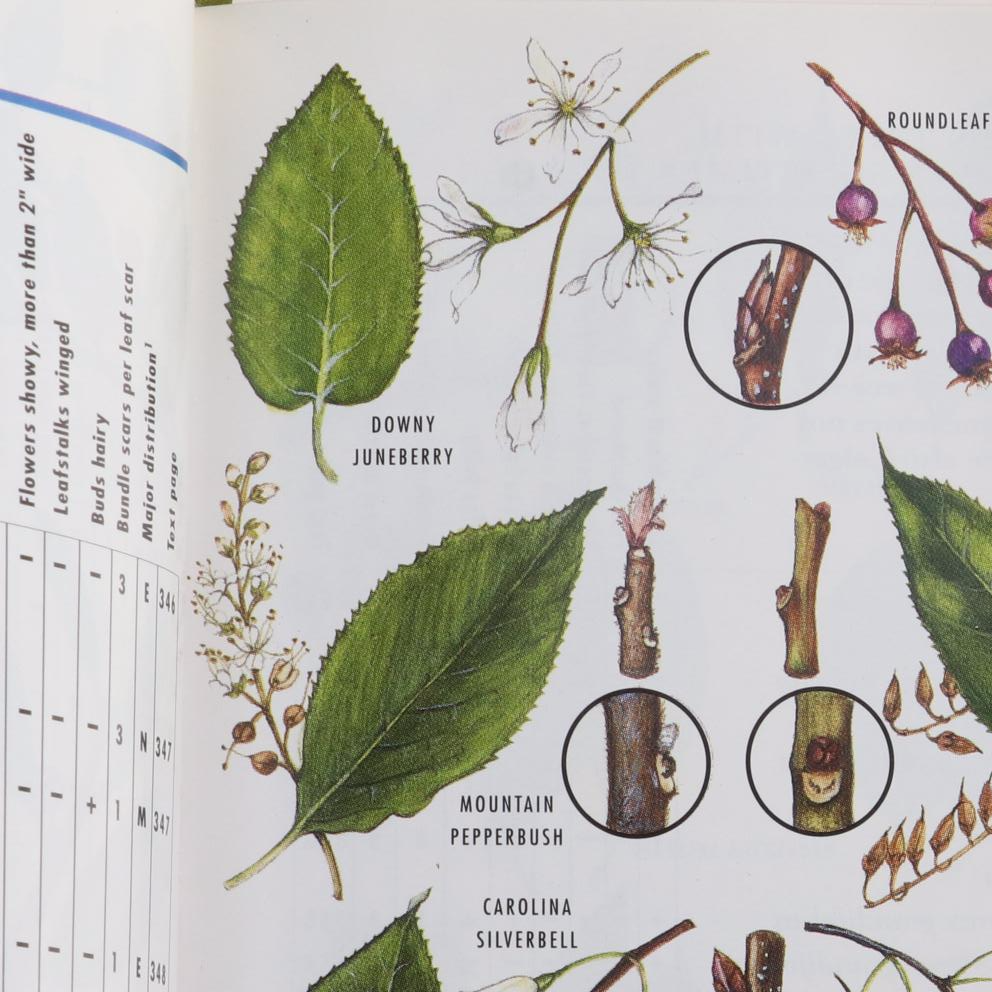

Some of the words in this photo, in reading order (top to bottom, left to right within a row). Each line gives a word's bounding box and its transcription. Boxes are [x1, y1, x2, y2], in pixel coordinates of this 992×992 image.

[887, 111, 990, 130] ROUNDLEAF
[17, 133, 36, 181] wide
[18, 224, 36, 270] than
[24, 279, 36, 331] more
[124, 263, 134, 305] scar
[119, 311, 133, 353] leaf
[19, 341, 40, 414] showy,
[54, 321, 74, 396] winged
[121, 360, 135, 396] per
[91, 413, 110, 468] hairy
[121, 403, 131, 455] scars
[371, 415, 435, 434] DOWNY
[19, 423, 36, 507] Flowers
[53, 406, 70, 515] Leafstalks
[170, 452, 178, 502] page
[352, 447, 453, 466] JUNEBERRY
[91, 476, 105, 525] Buds
[116, 464, 130, 533] Bundle
[142, 481, 156, 542] Major
[167, 508, 176, 550] Text
[159, 588, 176, 615] 346
[155, 736, 172, 762] 347
[153, 811, 170, 836] 347
[459, 794, 554, 813] MOUNTAIN
[450, 827, 563, 846] PEPPERBUSH
[483, 897, 572, 916] CAROLINA
[476, 930, 578, 949] SILVERBELL
[150, 961, 166, 986] 348
